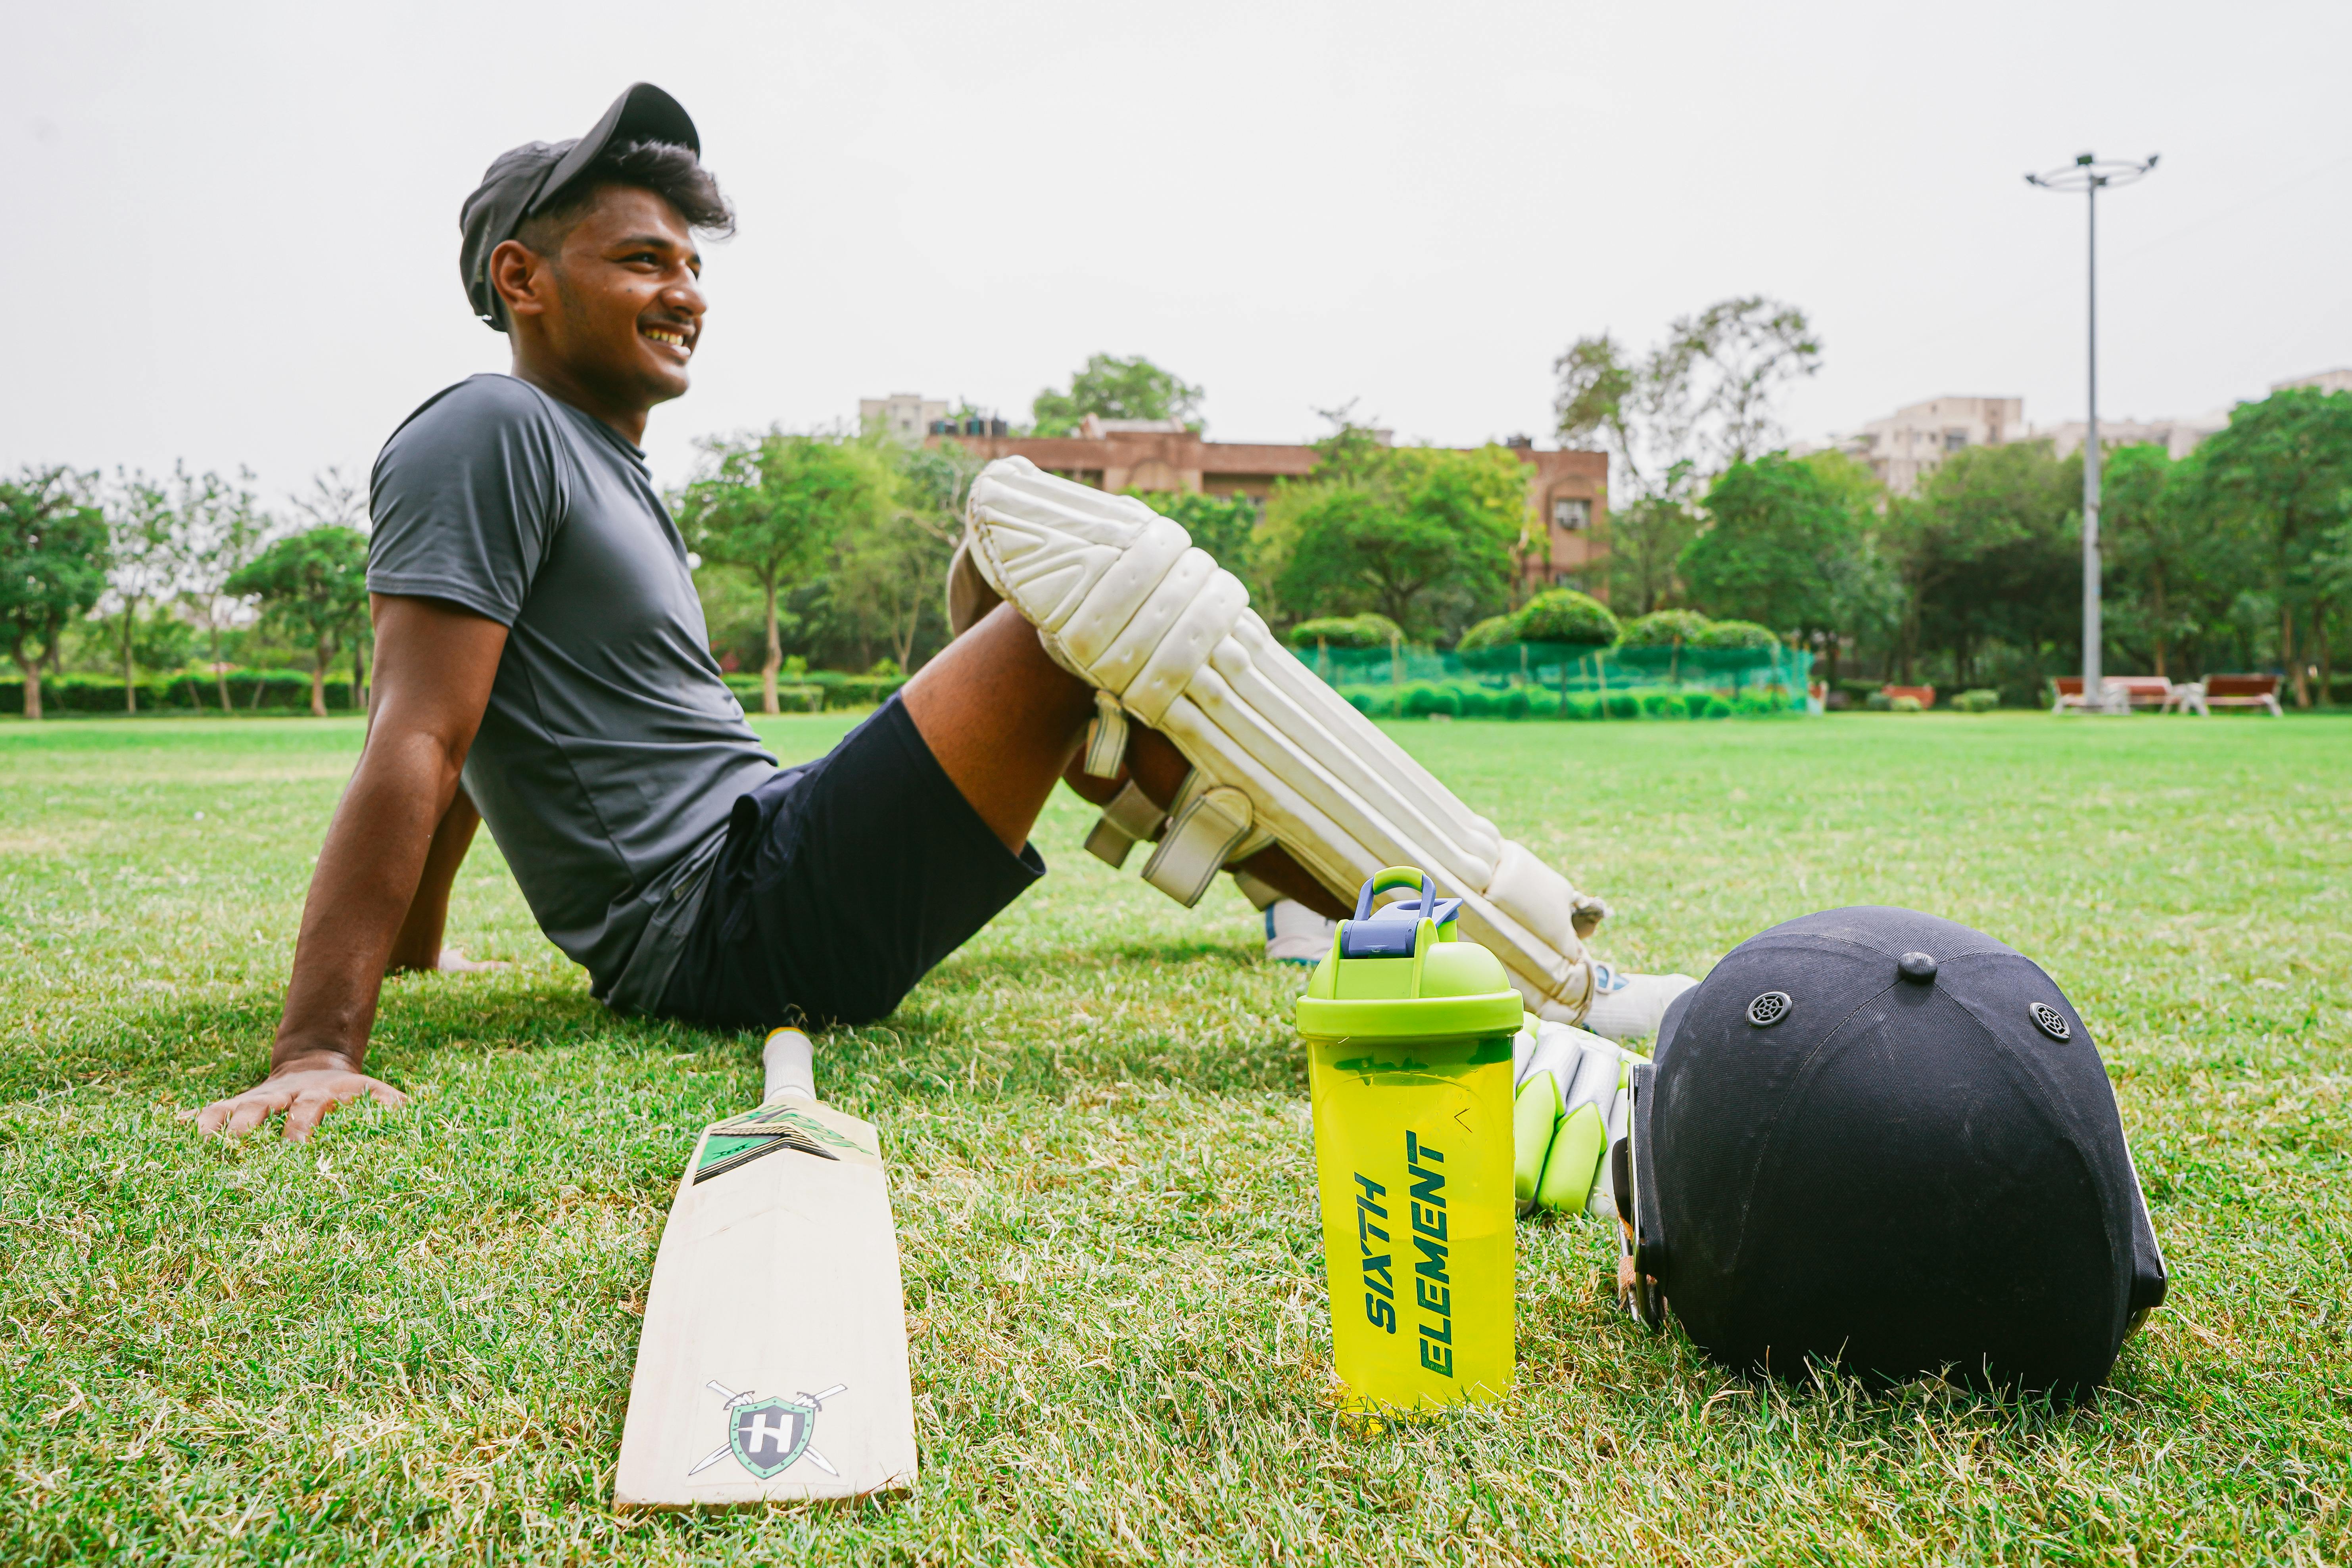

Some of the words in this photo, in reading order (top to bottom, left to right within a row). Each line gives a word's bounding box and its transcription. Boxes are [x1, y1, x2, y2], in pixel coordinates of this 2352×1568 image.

[1354, 1171, 1396, 1335] SIXTH
[1406, 1130, 1453, 1378] ELEMENT
[747, 1413, 794, 1453] H
